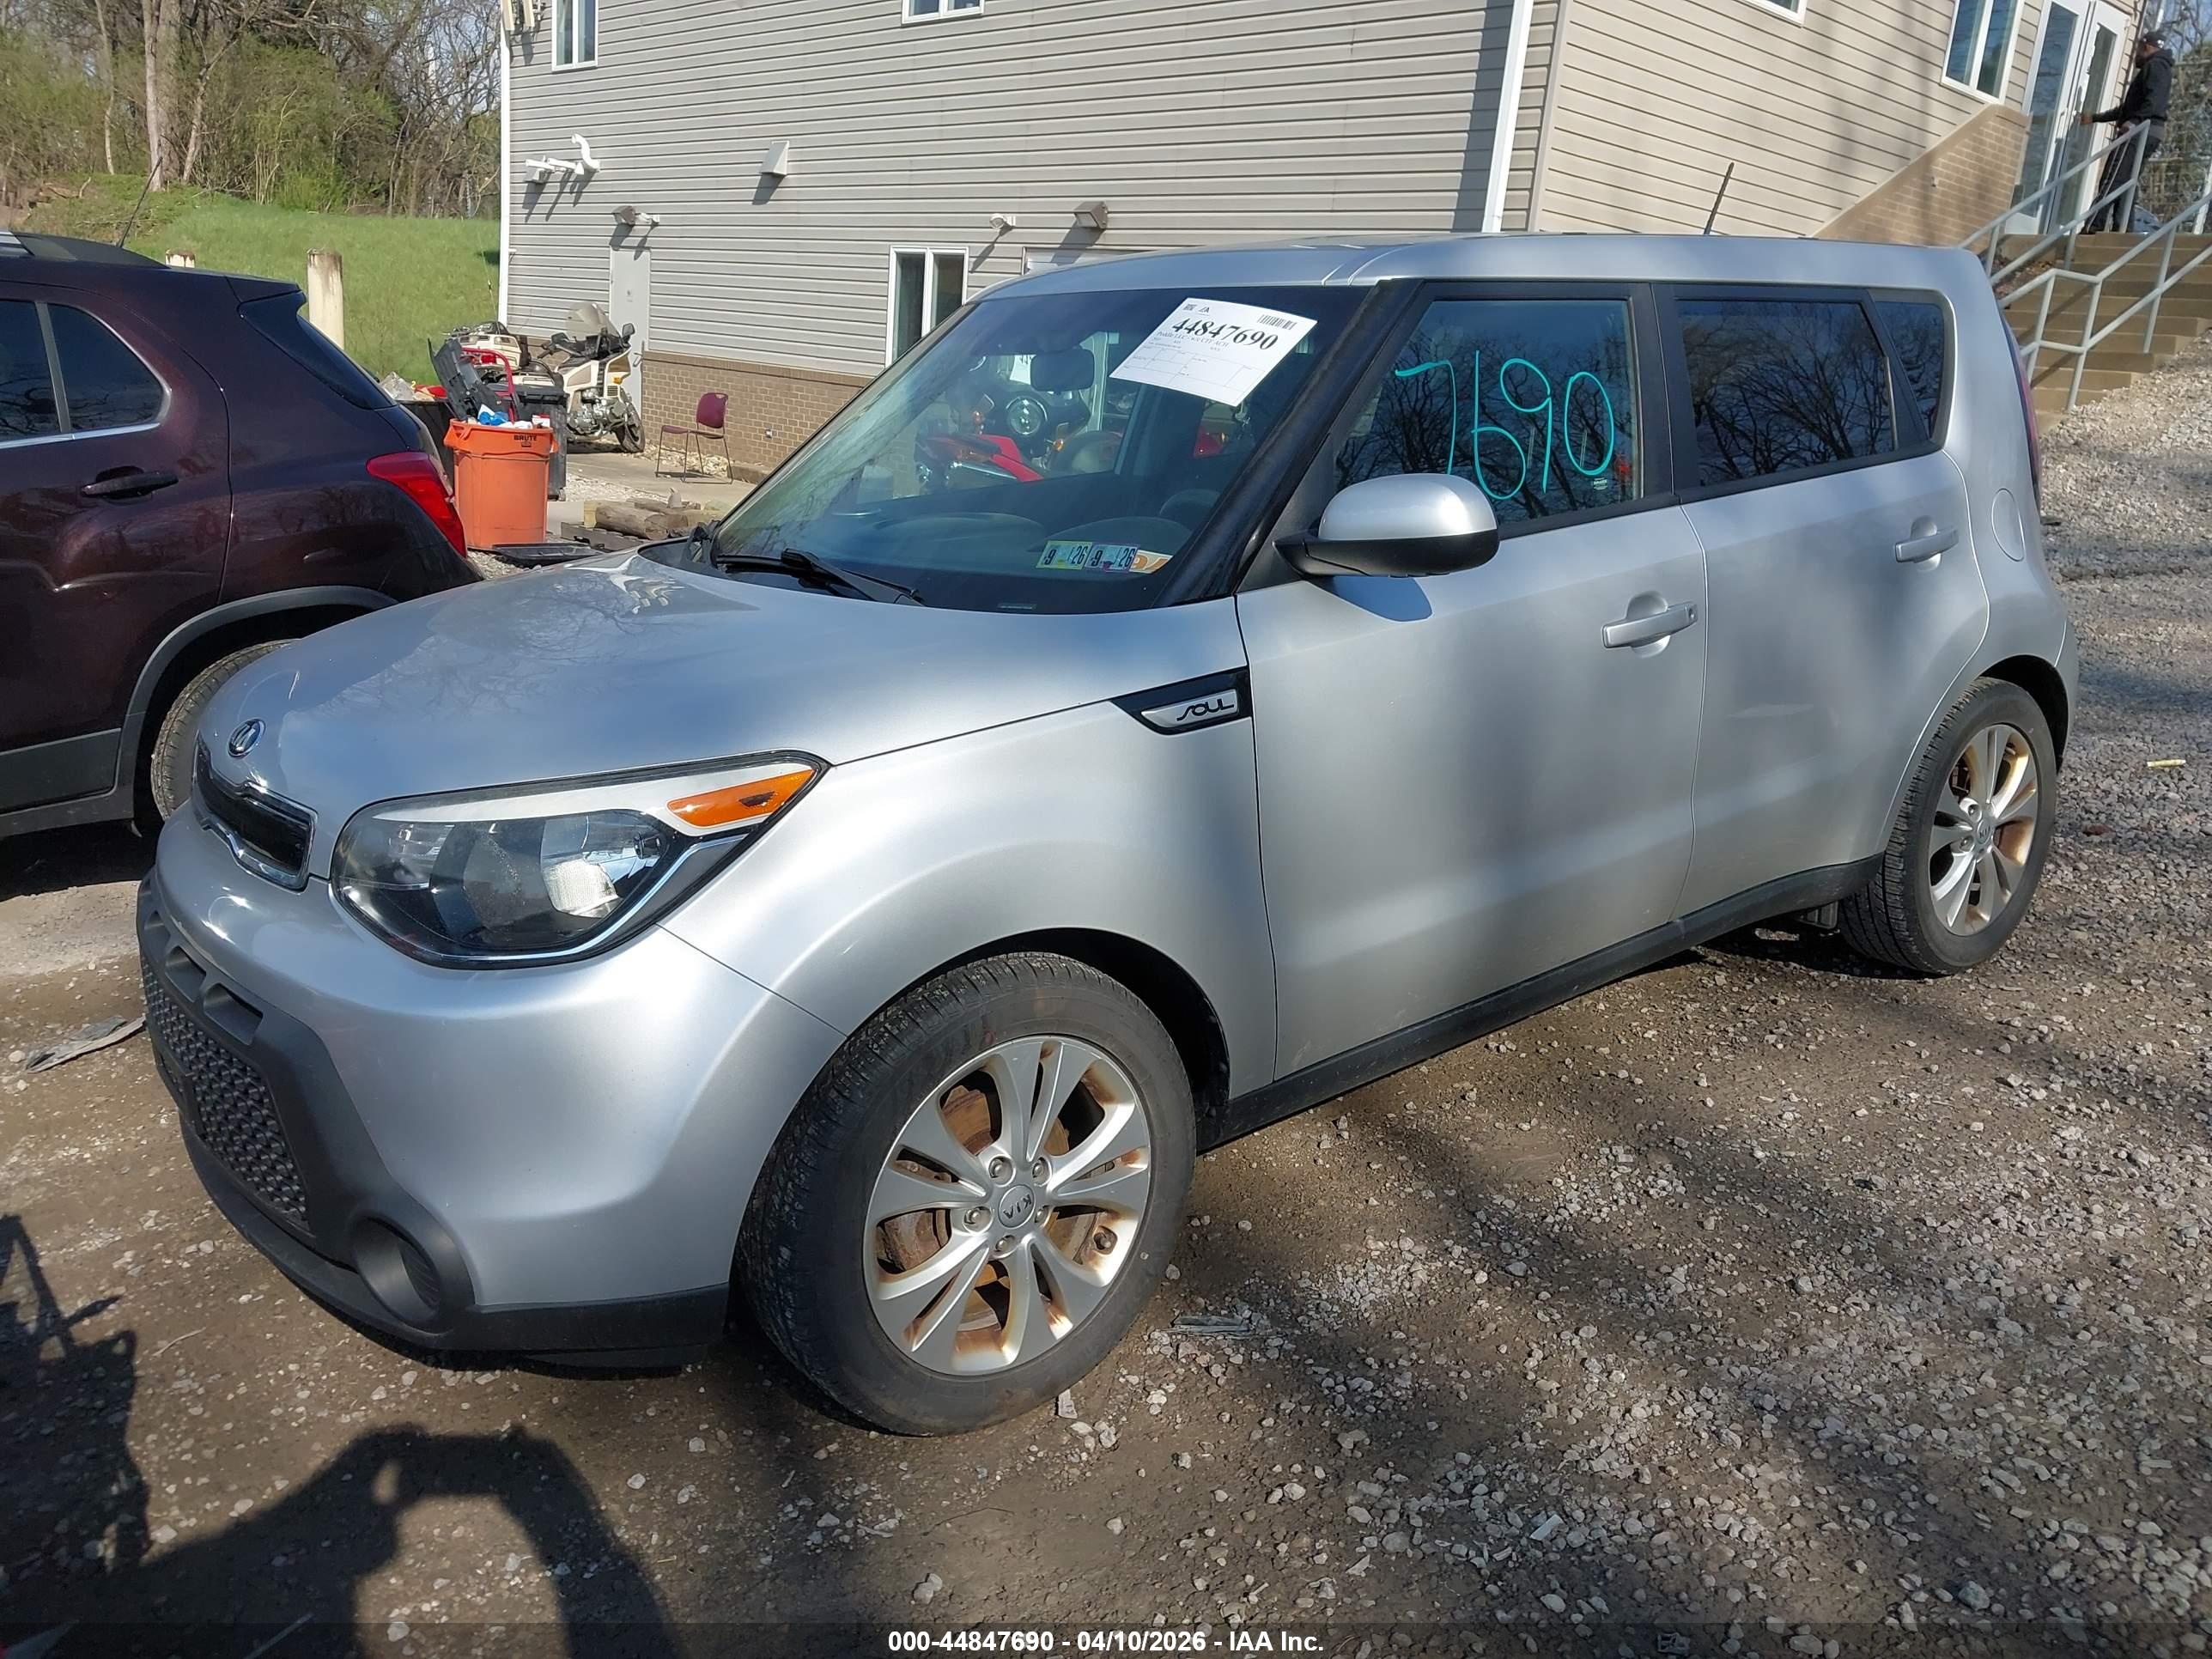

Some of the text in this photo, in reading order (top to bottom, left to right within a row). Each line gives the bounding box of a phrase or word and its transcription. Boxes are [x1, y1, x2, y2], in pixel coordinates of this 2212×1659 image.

[1172, 318, 1278, 350] 44847690
[1395, 349, 1614, 500] 7690
[1044, 549, 1056, 565] 9
[1091, 550, 1103, 567] 9
[1176, 698, 1235, 721] SOUL
[1003, 1194, 1032, 1219] KIA
